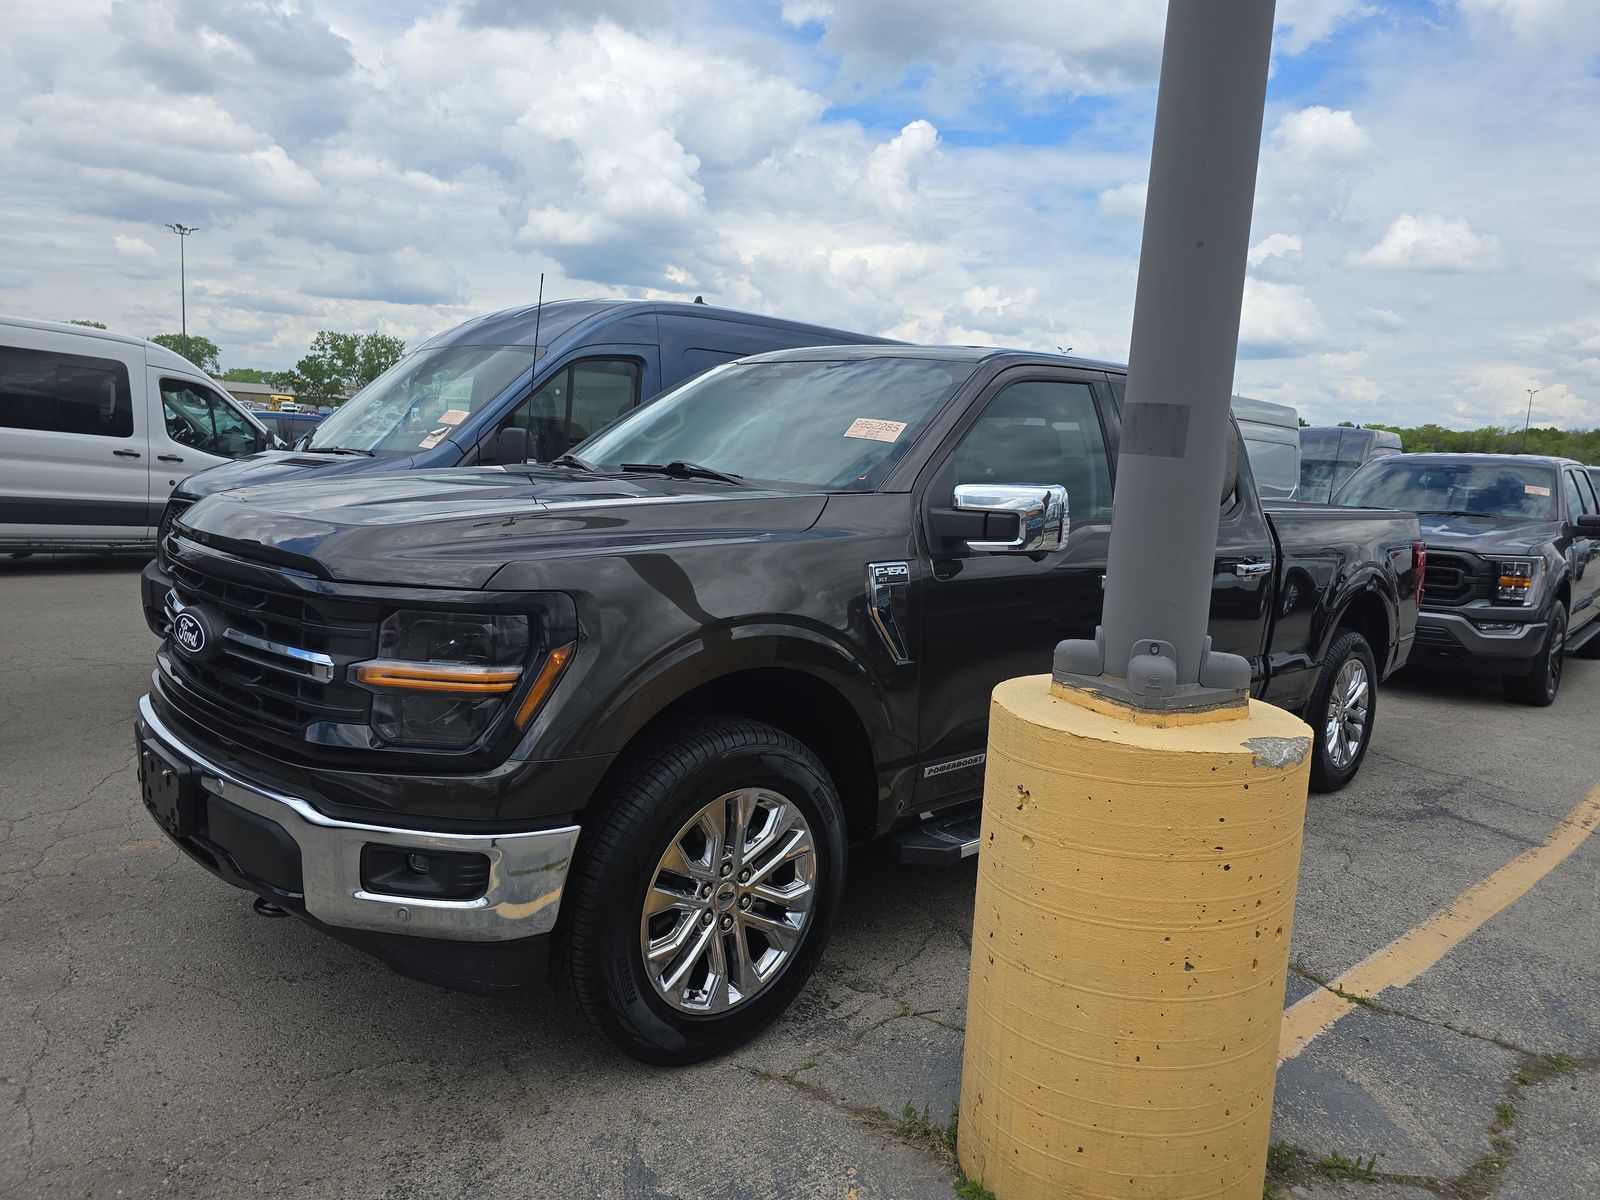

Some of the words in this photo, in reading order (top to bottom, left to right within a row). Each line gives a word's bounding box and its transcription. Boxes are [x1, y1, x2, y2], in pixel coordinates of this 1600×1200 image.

[875, 566, 907, 577] F-150
[178, 617, 199, 647] Ford
[927, 755, 983, 776] POWERBOOST
